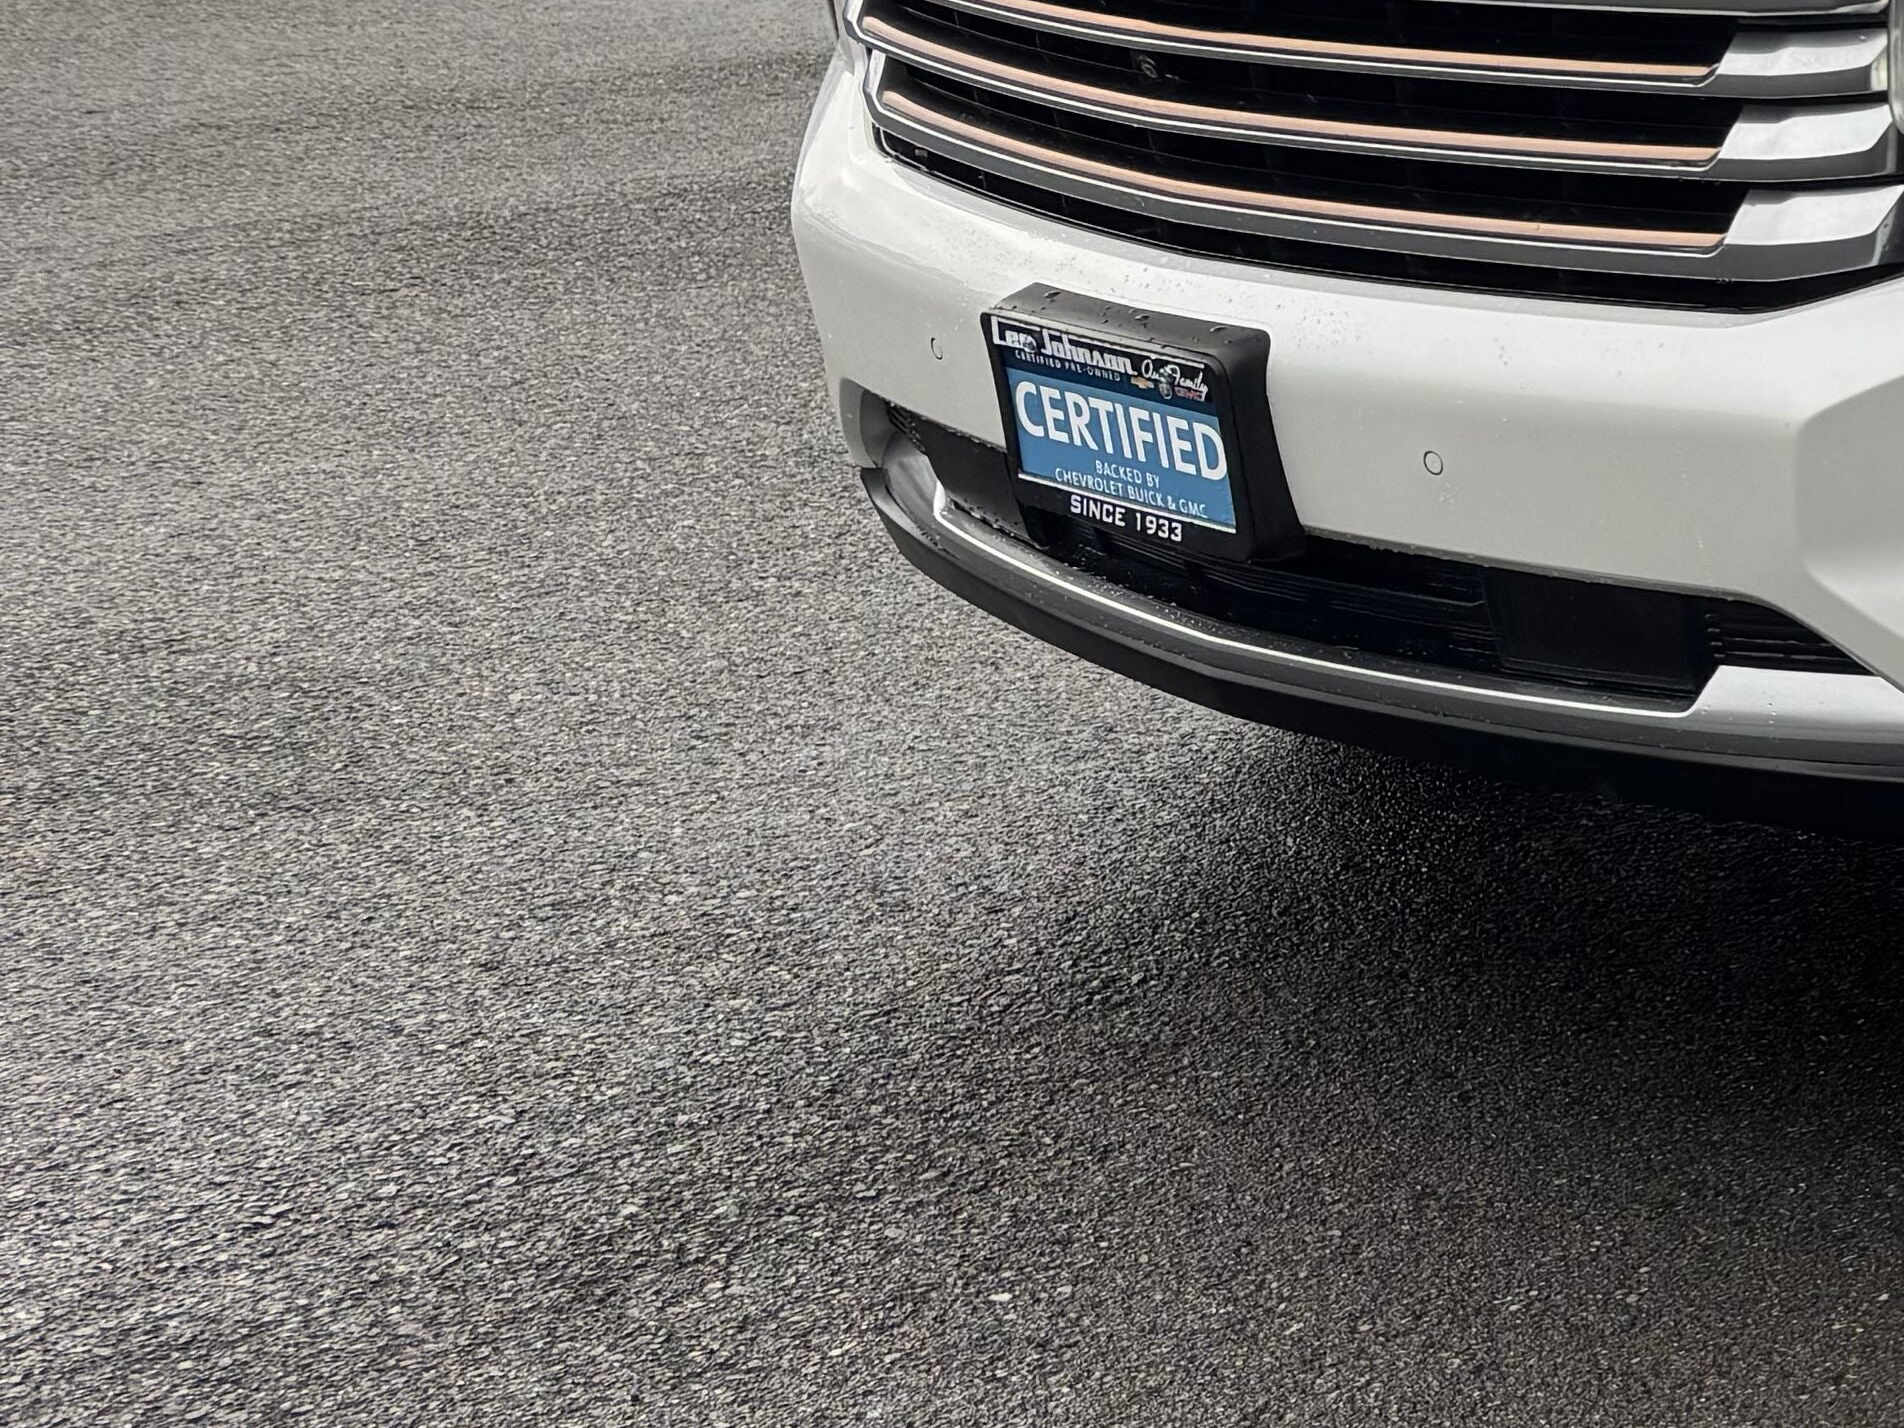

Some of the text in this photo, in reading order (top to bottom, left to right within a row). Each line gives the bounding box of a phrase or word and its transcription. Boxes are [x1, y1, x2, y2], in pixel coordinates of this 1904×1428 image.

[1015, 350, 1062, 369] CERTIFIED
[1041, 328, 1138, 376] Johnson
[1015, 381, 1228, 481] CERTIFIED
[1055, 467, 1209, 519] CHEVROLET BUICK & GMC
[1095, 460, 1160, 489] BACKED BY
[1070, 494, 1183, 542] SINCE 1933
